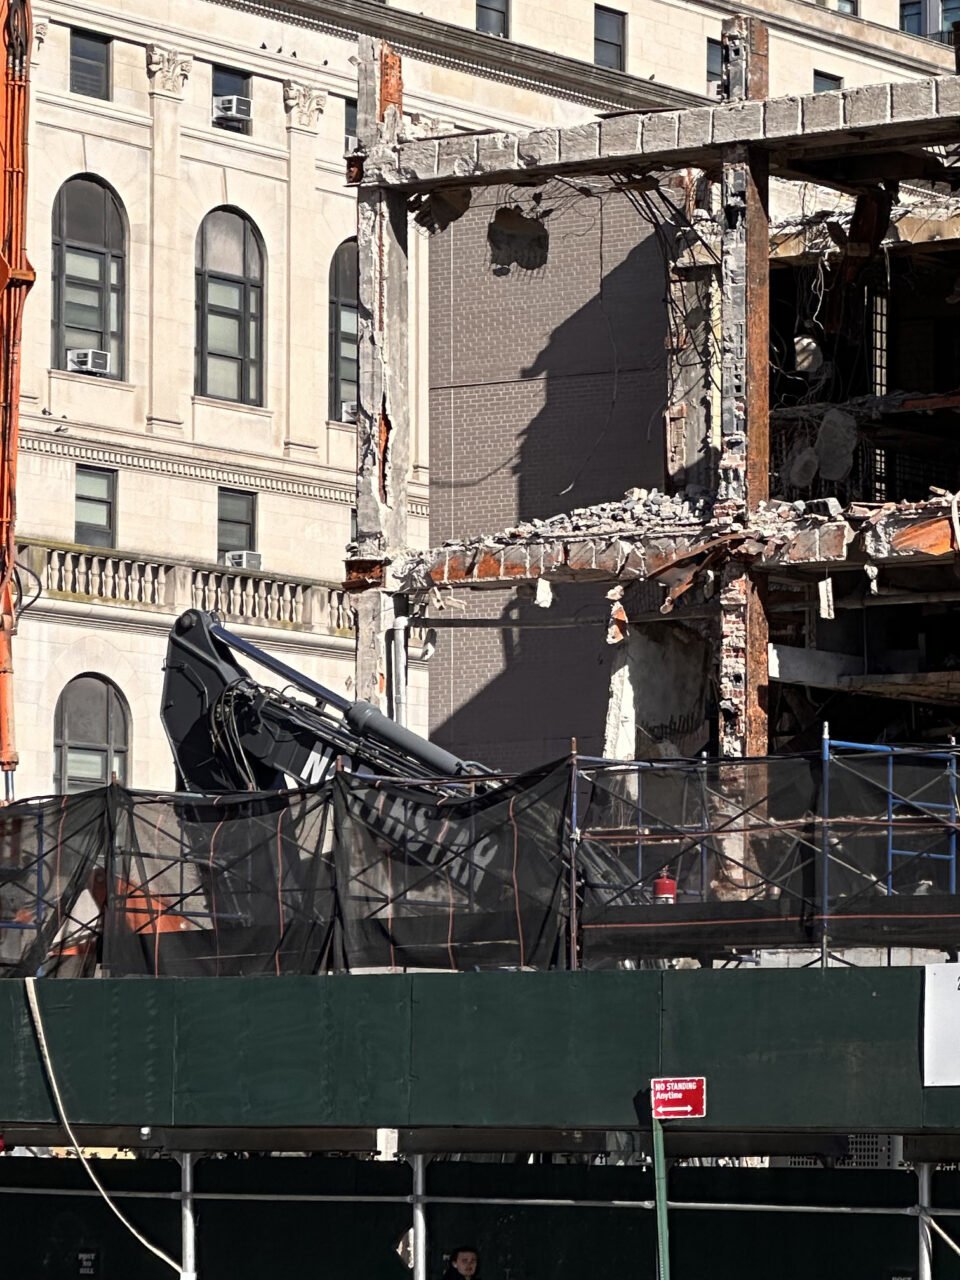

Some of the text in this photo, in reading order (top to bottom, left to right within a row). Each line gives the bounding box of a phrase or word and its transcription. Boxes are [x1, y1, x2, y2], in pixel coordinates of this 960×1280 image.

[655, 1082, 697, 1091] NO STANDING
[656, 1092, 682, 1100] Anytime
